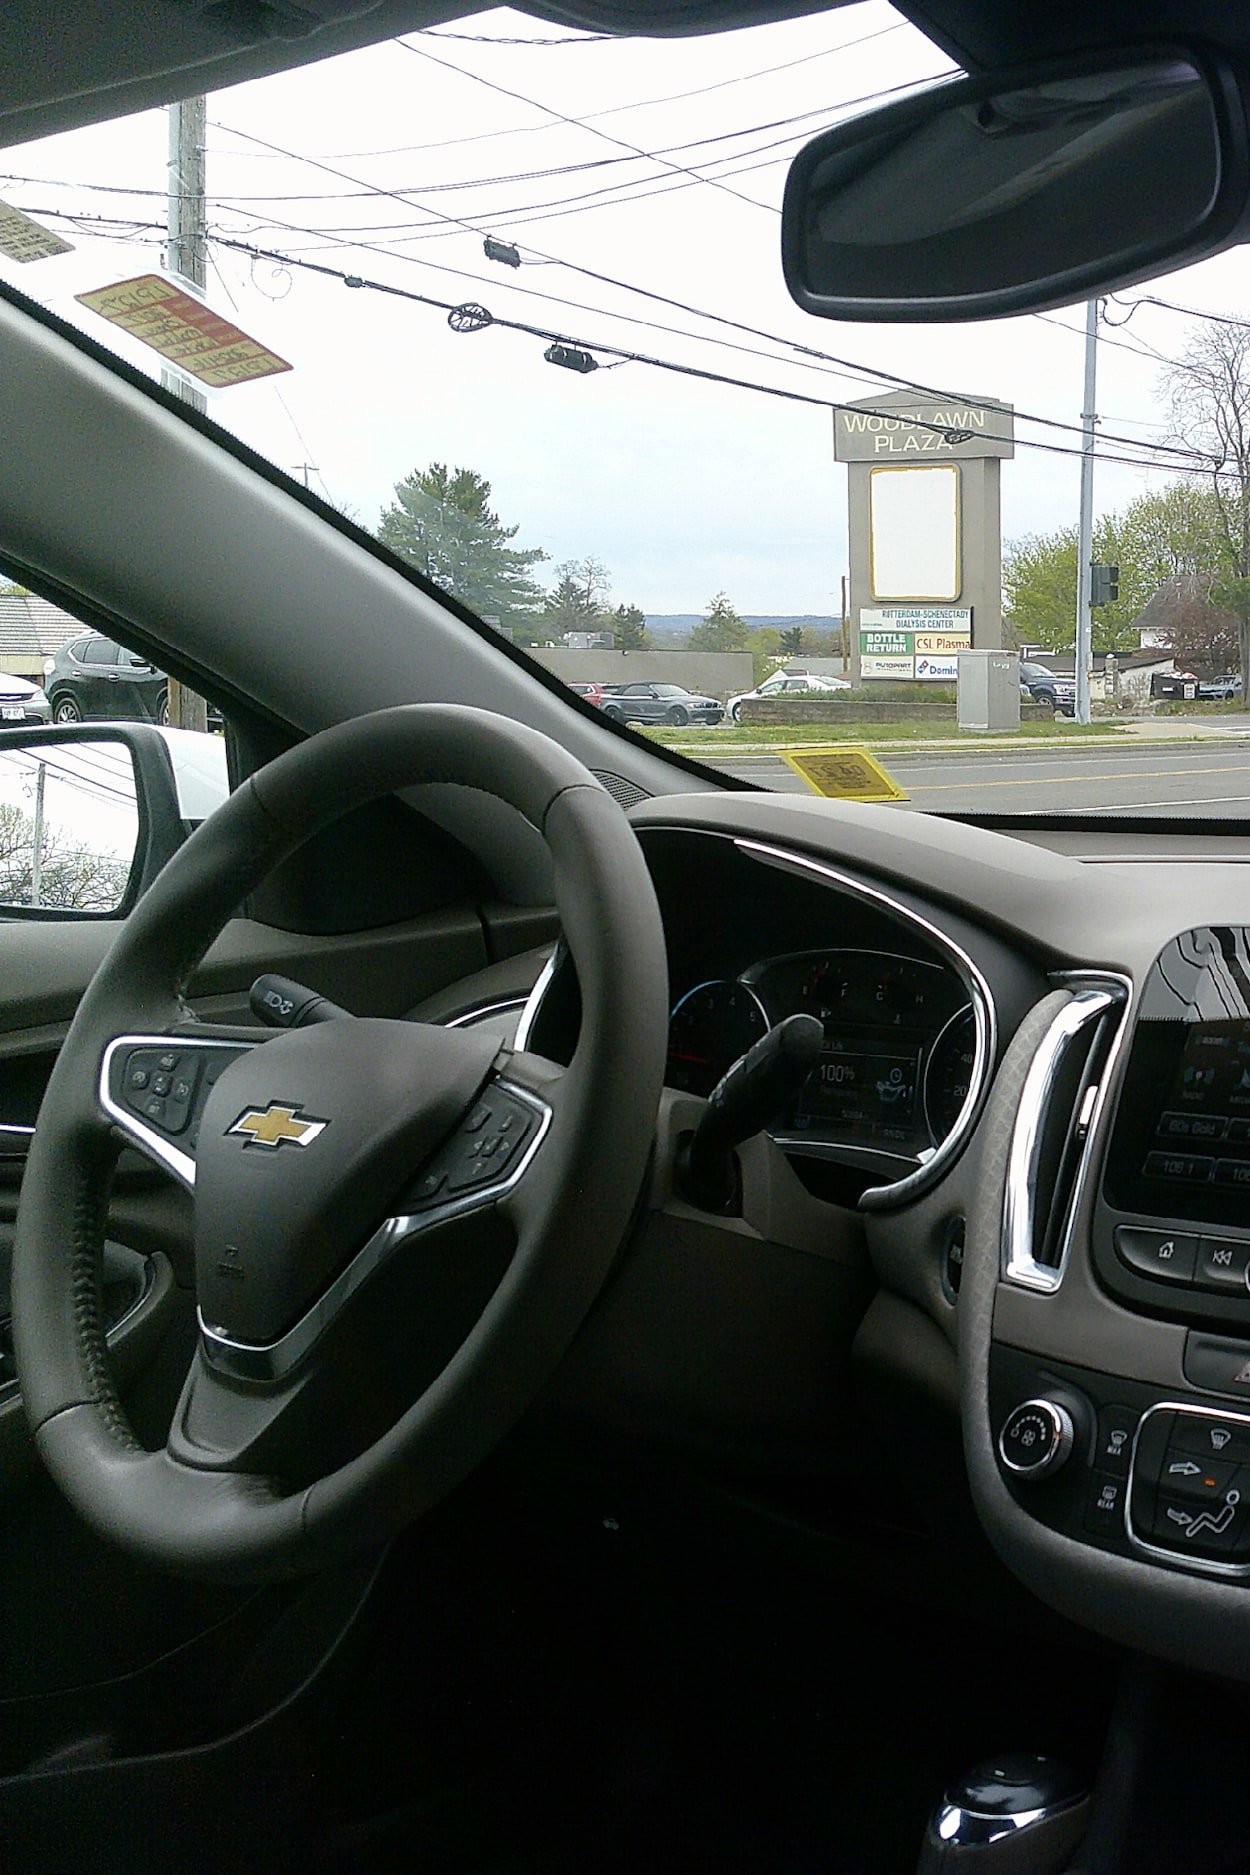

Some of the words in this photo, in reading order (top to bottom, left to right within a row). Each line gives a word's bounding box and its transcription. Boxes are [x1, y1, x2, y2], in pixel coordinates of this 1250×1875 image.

[844, 410, 986, 433] WOODLAWN
[874, 433, 954, 453] PLAZA
[882, 610, 969, 619] ROTTERDAM-SCHENECTADY
[896, 620, 926, 629] DIALYSIS
[927, 620, 954, 629] CENTER
[866, 633, 906, 643] BOTTLE
[916, 638, 932, 649] CSL
[936, 638, 971, 649] Plasma
[866, 643, 907, 653] RETURN
[929, 665, 958, 675] Domin
[820, 1064, 856, 1082] 100%
[953, 1085, 968, 1097] 20
[1097, 1498, 1115, 1511] REAR
